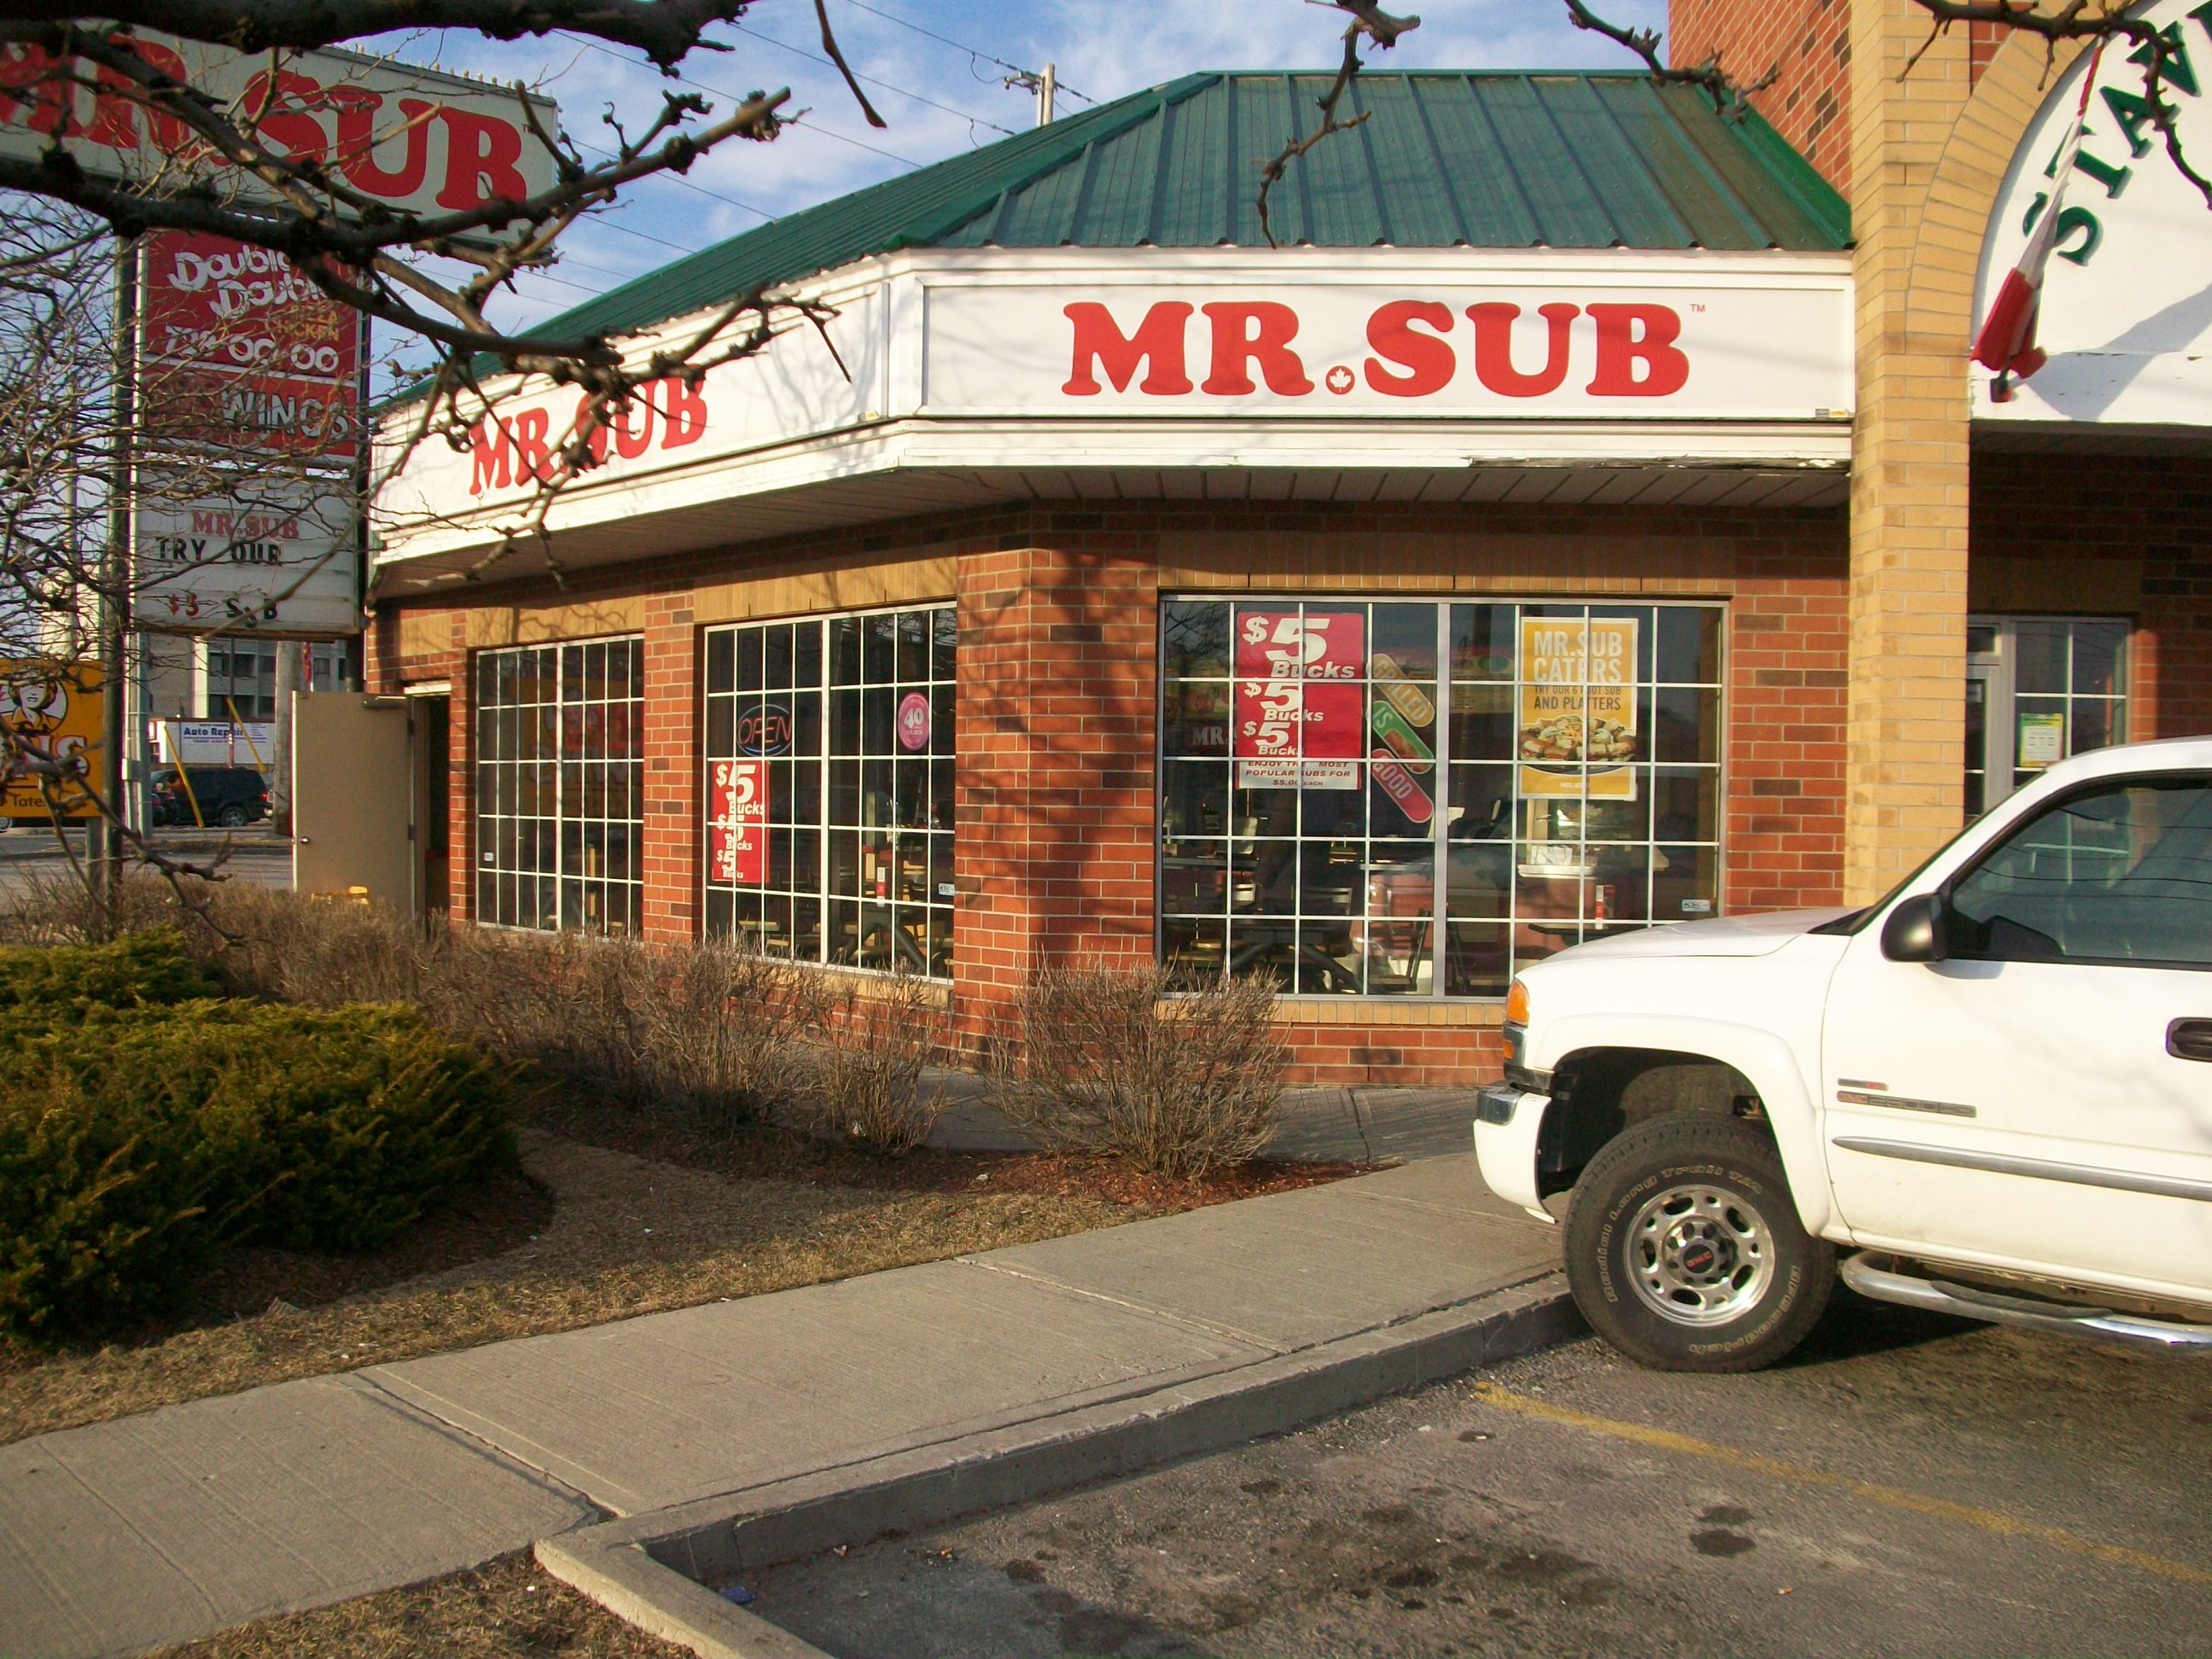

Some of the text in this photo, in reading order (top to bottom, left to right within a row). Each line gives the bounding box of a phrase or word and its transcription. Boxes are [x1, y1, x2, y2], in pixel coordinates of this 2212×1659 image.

[220, 386, 350, 440] WINGS
[156, 537, 282, 564] TRY OUR
[1271, 661, 1356, 678] Bucks
[1534, 657, 1623, 683] CATERS
[1372, 660, 1429, 722] GRILLED
[1552, 685, 1569, 696] OUR
[1580, 685, 1601, 696] FOT
[1604, 686, 1622, 696] SUB
[1534, 696, 1558, 710] AND
[904, 707, 924, 729] 40
[1263, 708, 1324, 722] Bucks
[1371, 707, 1394, 729] IS
[183, 727, 209, 736] Auto
[737, 716, 792, 744] OPEN
[1257, 744, 1305, 756] Bucks
[1245, 769, 1295, 777] POPULAR
[1371, 755, 1414, 800] GOOD
[12, 794, 46, 807] Tate
[728, 800, 767, 816] Bucks
[726, 839, 754, 852] Bcks
